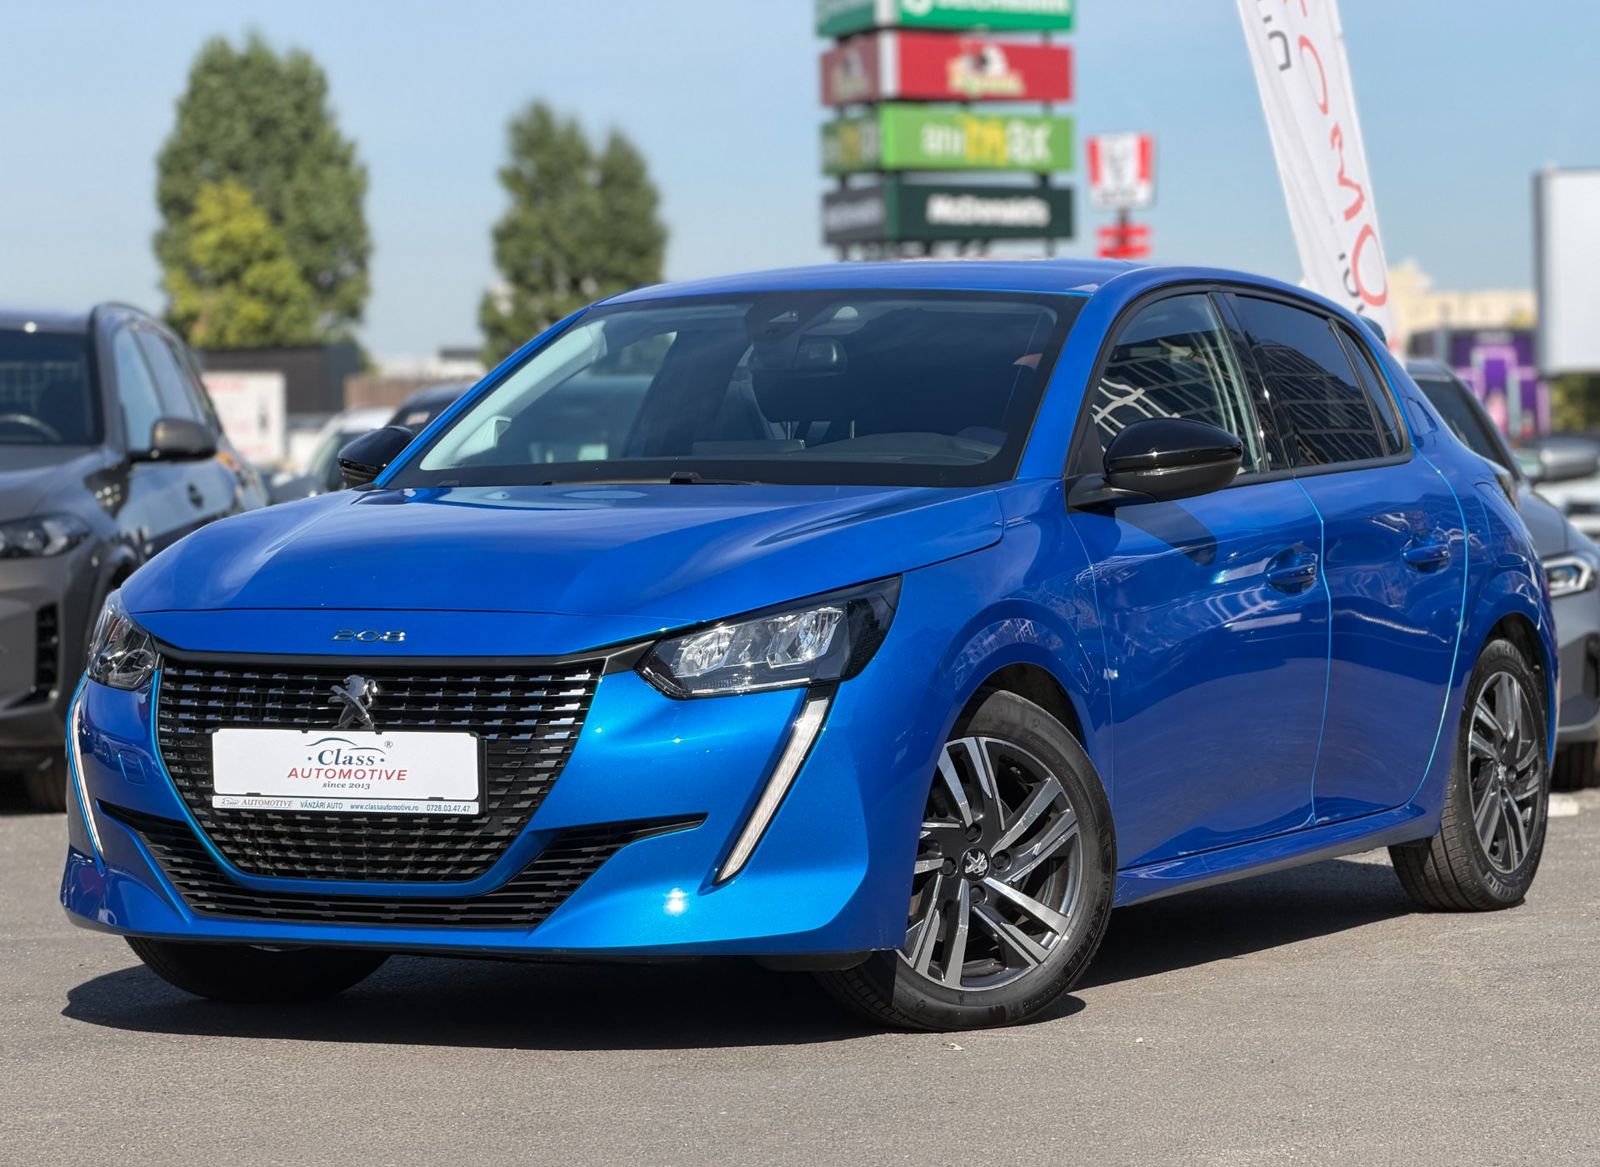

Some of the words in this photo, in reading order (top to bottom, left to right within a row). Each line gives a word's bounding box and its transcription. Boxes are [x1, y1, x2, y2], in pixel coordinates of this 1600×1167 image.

[332, 629, 405, 642] 208
[318, 748, 375, 766] Class
[287, 767, 407, 781] AUTOMOTIVE
[322, 780, 346, 789] since
[348, 782, 371, 790] 2013
[242, 799, 293, 808] AUTOMOTIVE
[326, 801, 343, 810] AUTO
[350, 802, 419, 812] www.classautomotive.ro
[426, 804, 471, 813] 0728.03.47.47
